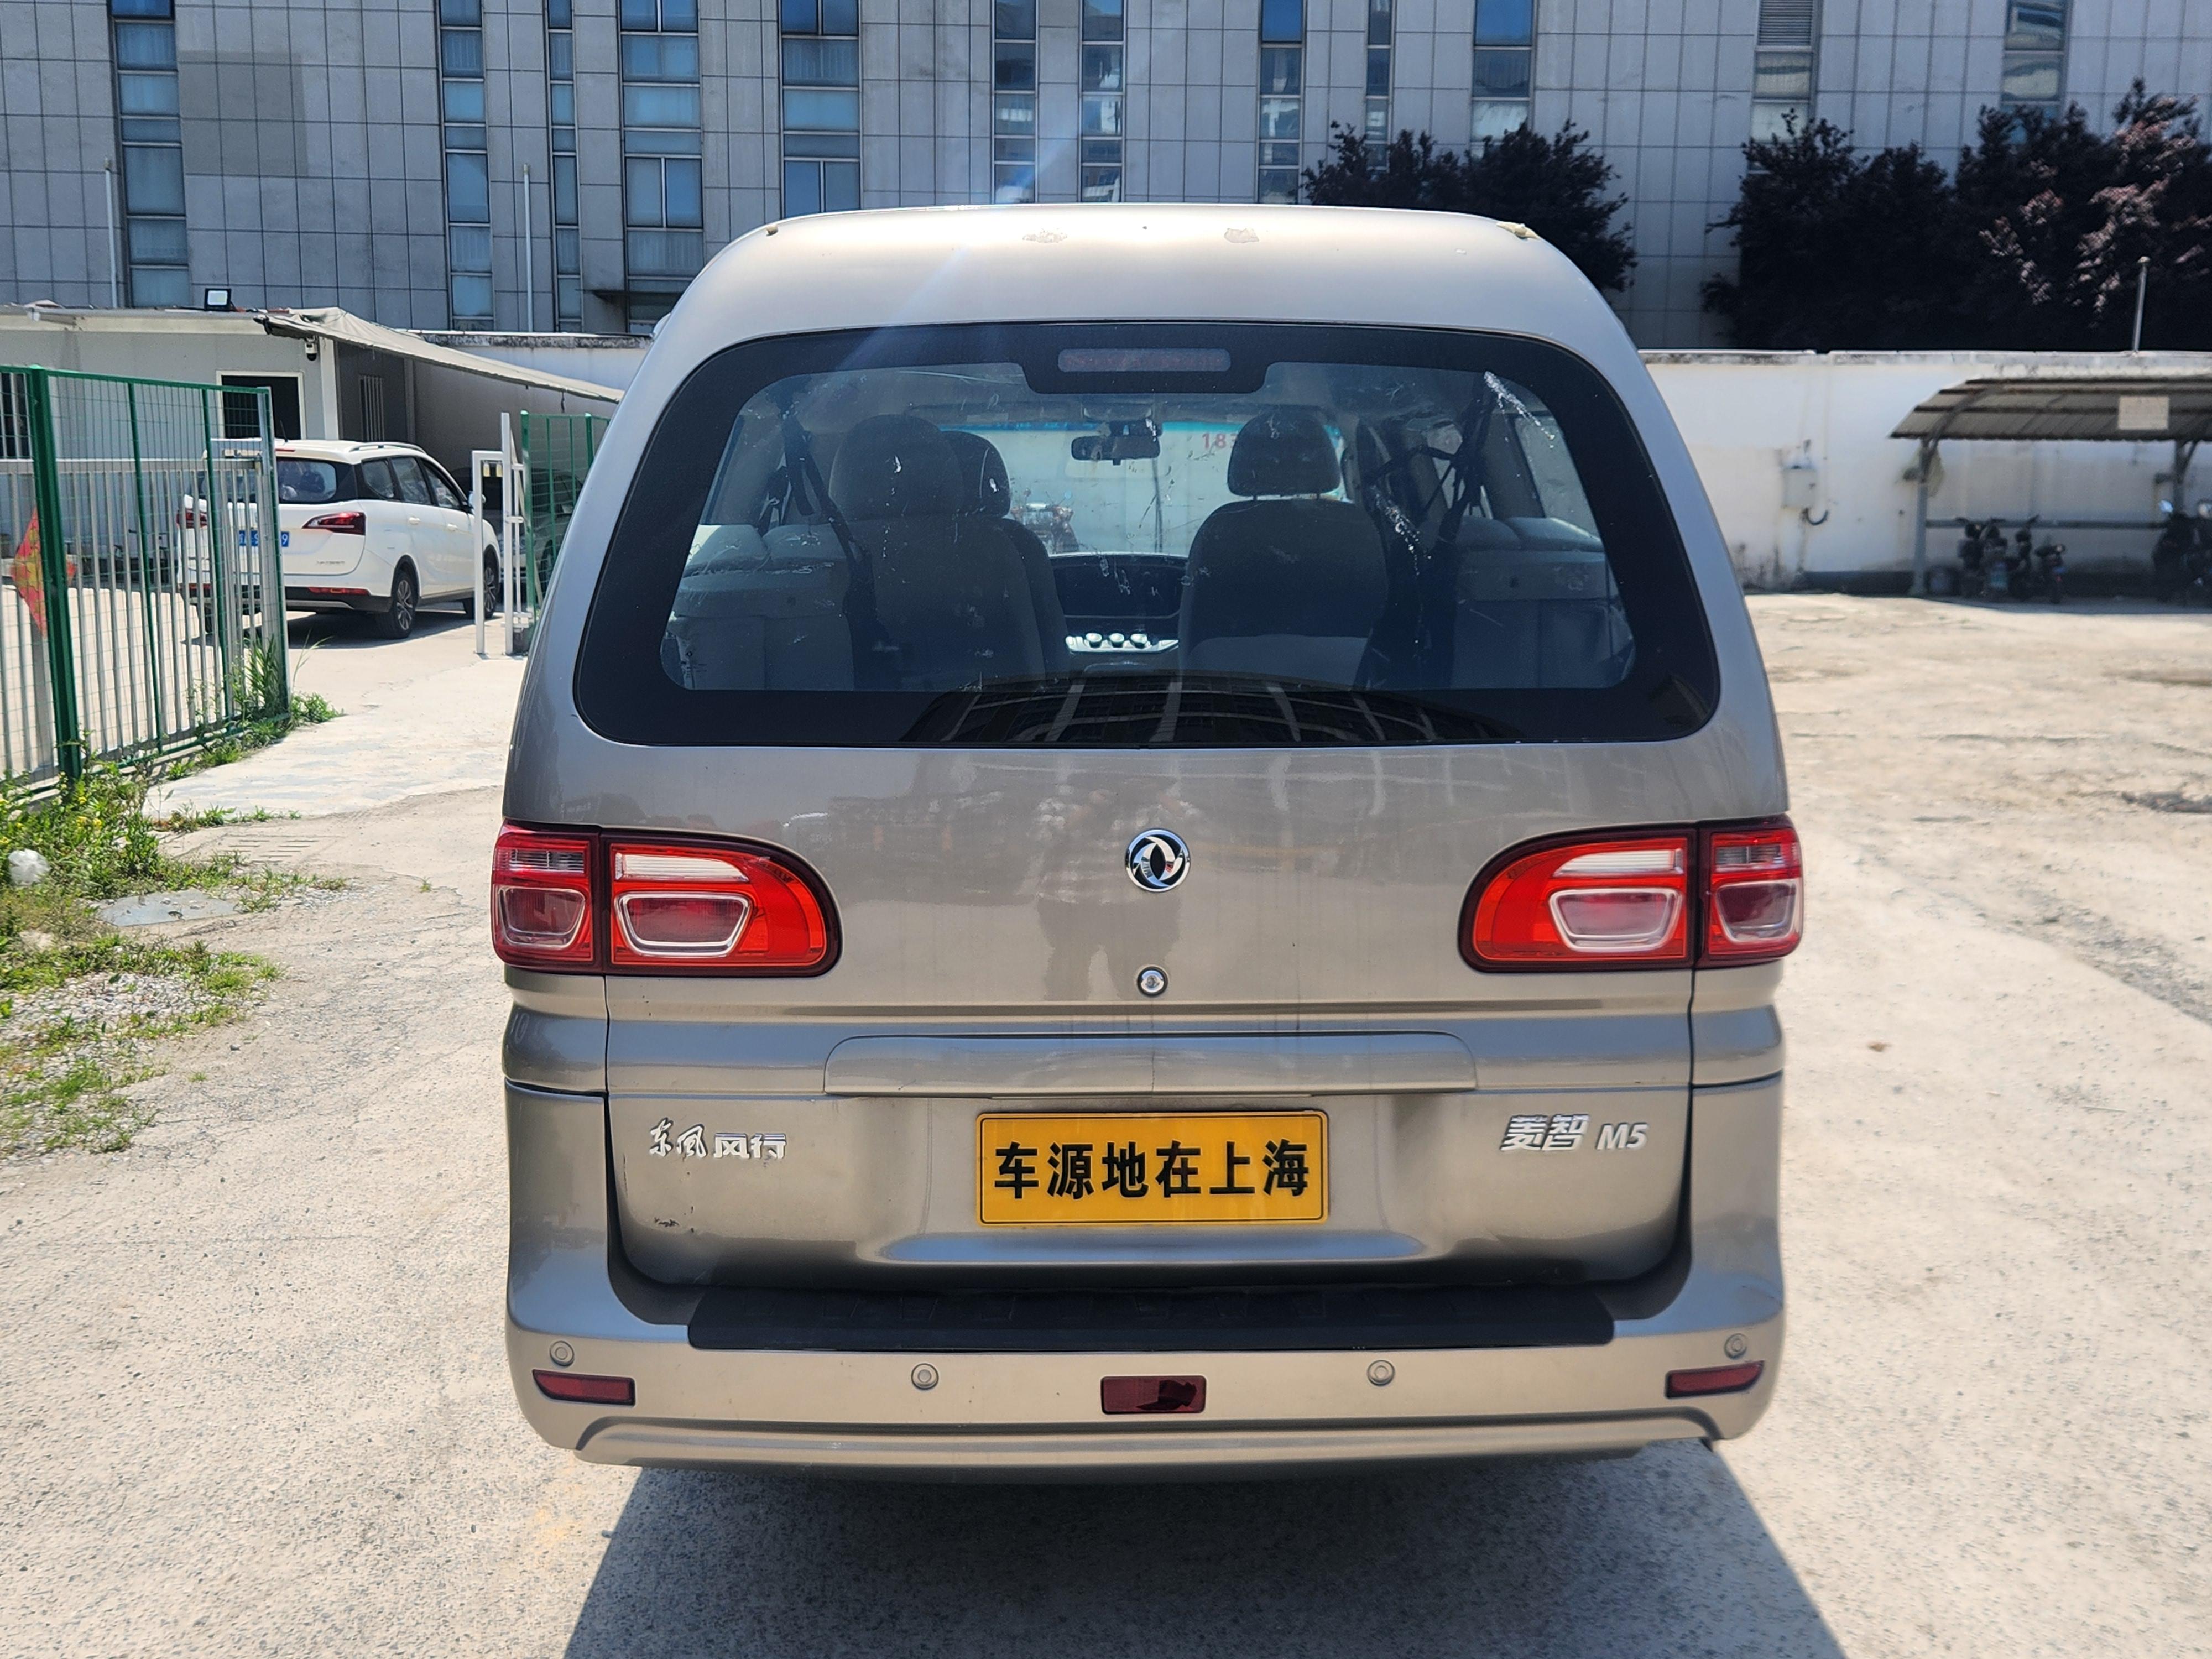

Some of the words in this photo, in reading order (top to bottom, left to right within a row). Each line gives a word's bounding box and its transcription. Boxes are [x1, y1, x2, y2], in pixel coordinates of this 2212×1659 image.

[1499, 1114, 1590, 1151] 菱智
[1596, 1123, 1649, 1150] M5
[994, 1138, 1310, 1200] 车源地在上海
